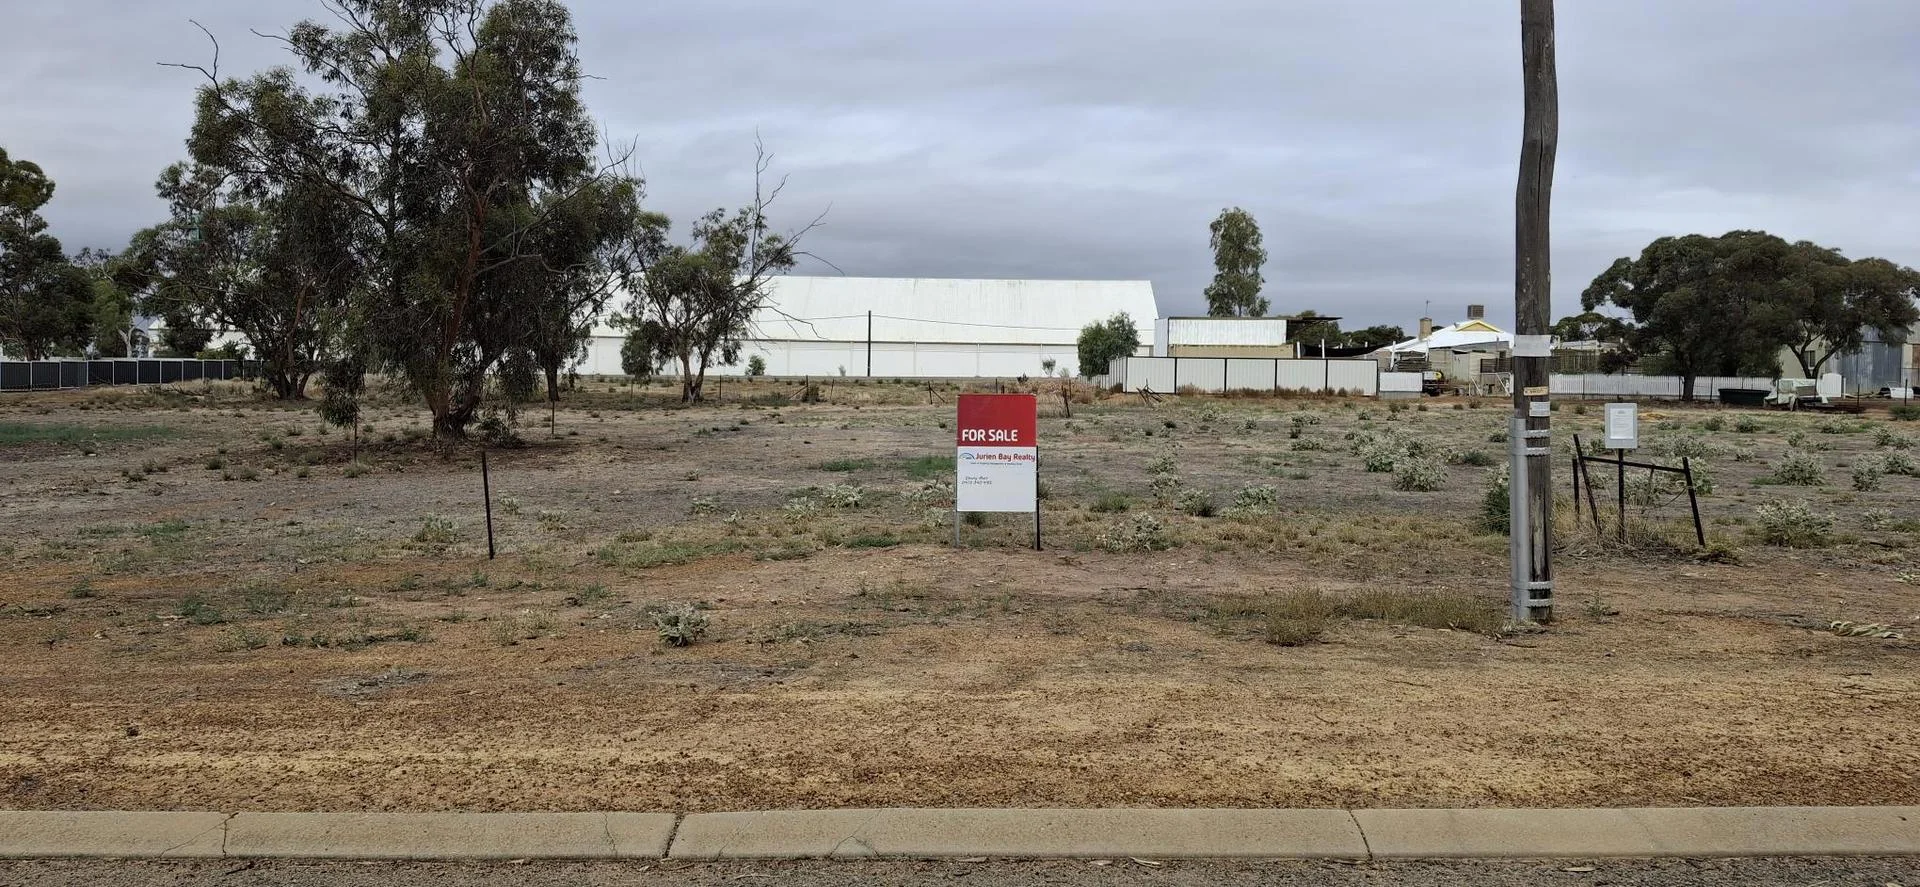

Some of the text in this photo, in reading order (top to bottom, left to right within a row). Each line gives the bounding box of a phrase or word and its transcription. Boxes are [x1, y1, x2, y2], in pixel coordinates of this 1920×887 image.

[962, 429, 1018, 442] FOR SALE
[999, 453, 1012, 462] Bay
[1014, 453, 1036, 462] Realty
